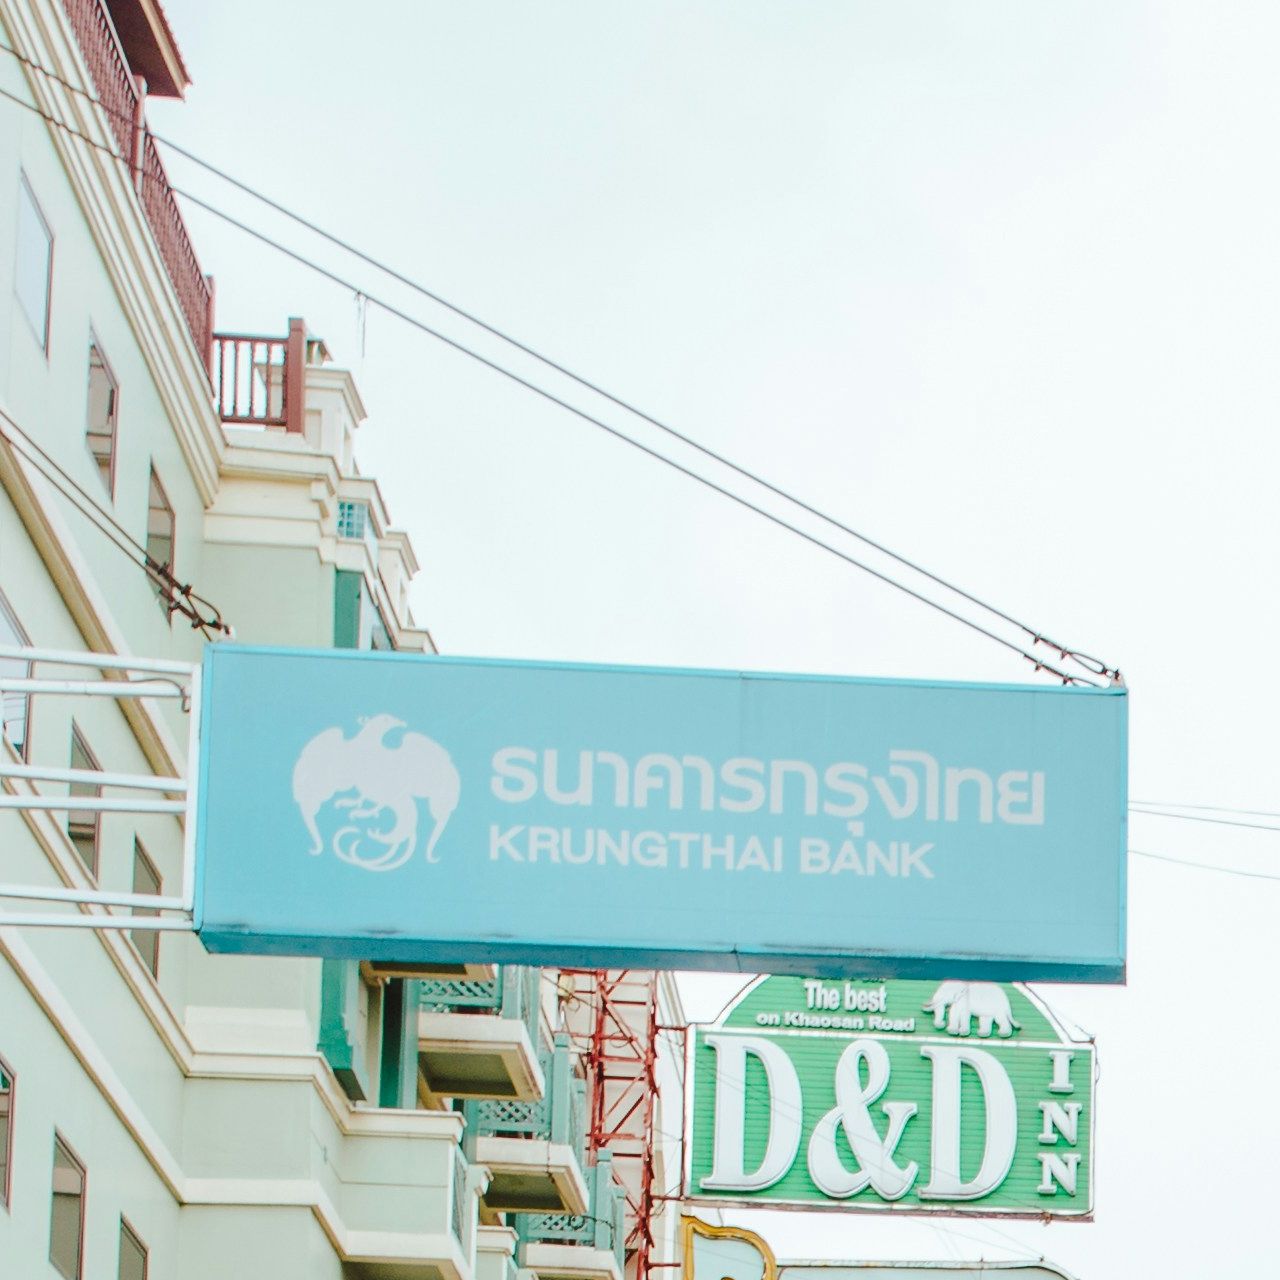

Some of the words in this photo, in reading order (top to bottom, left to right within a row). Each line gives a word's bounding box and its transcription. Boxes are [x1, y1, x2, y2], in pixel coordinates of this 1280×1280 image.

[490, 745, 1045, 834] ธนาคารกรุงไทย
[489, 824, 782, 875] KRUNGTHAI
[799, 835, 935, 880] BANK
[756, 1012, 780, 1026] on
[784, 1010, 864, 1031] Khaosan
[868, 1015, 916, 1032] Road
[804, 981, 840, 1011] The
[845, 982, 888, 1013] best
[701, 1033, 1018, 1201] D&D
[1038, 1051, 1082, 1197] INN
